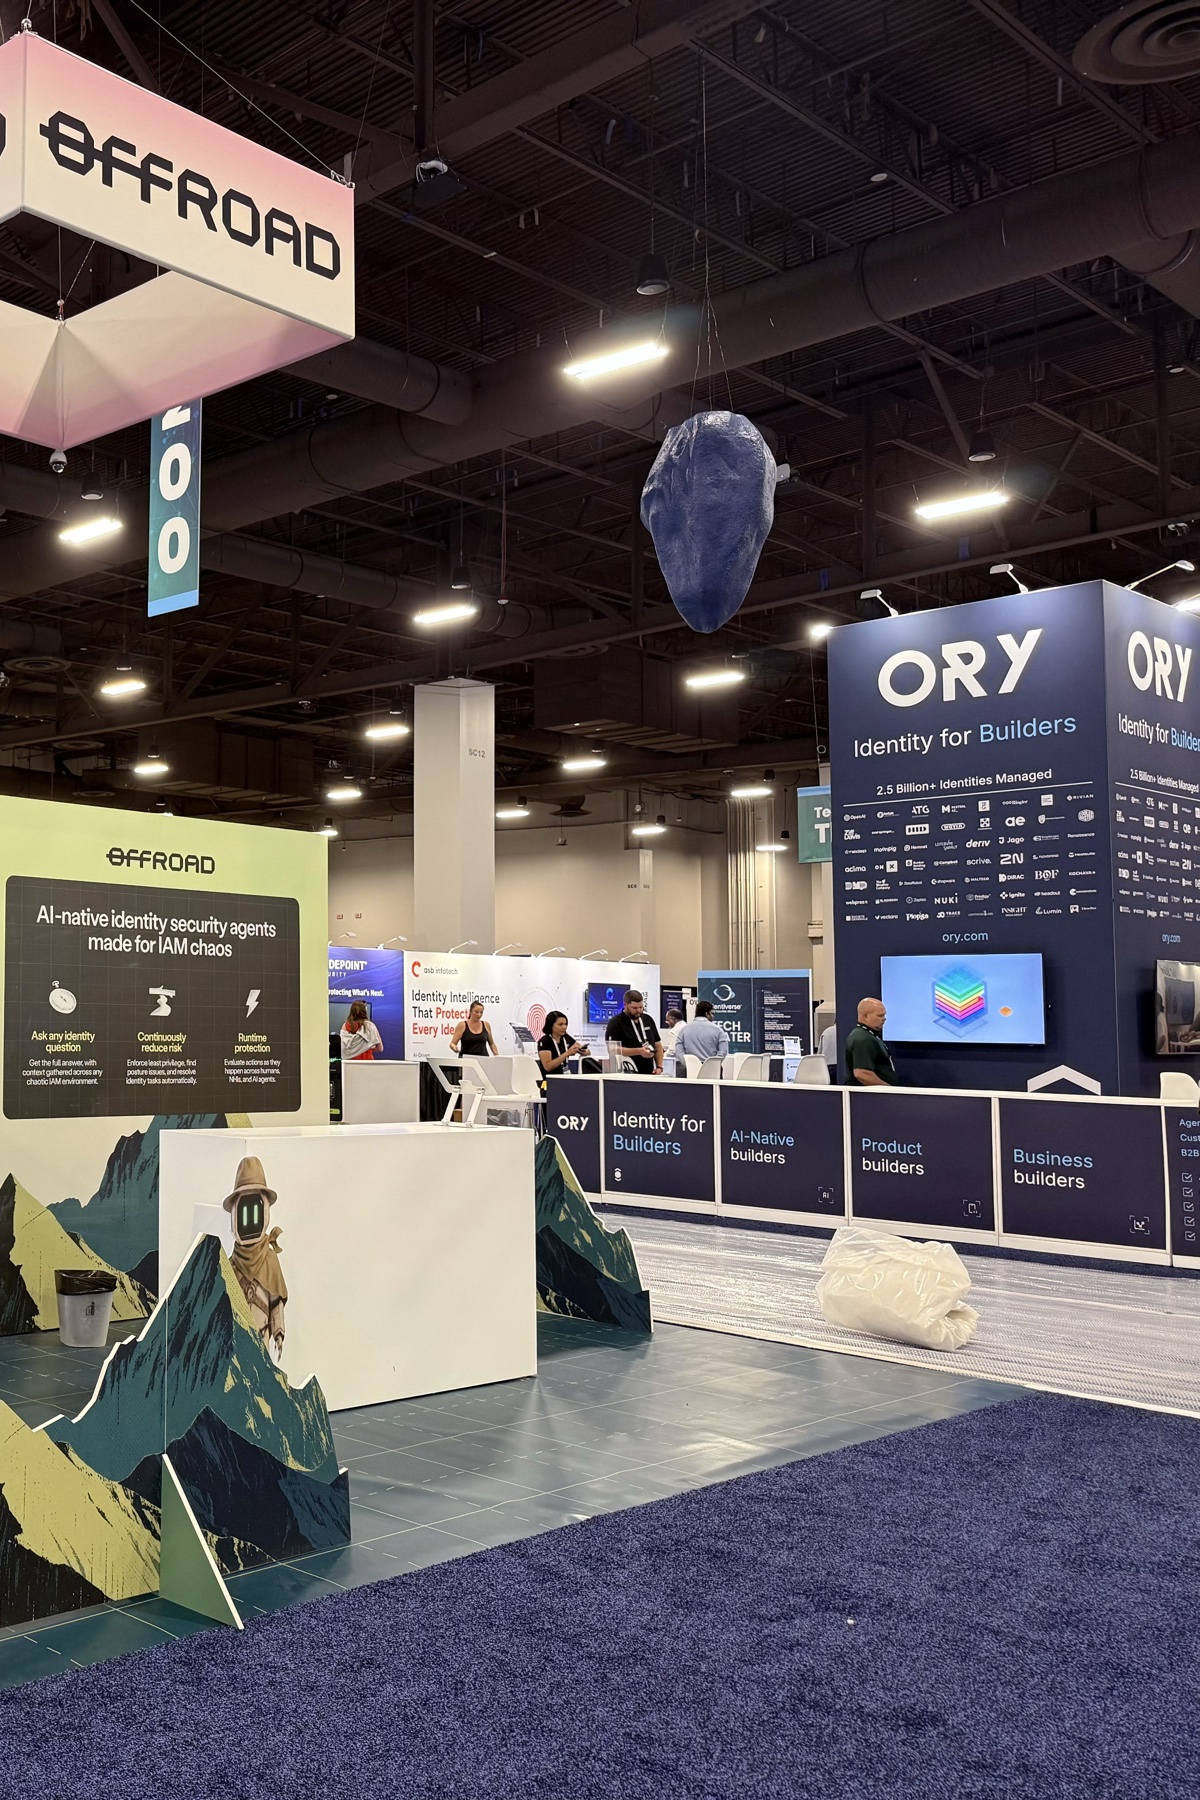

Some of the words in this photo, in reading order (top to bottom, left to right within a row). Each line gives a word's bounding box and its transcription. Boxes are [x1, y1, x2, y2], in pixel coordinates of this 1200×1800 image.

[39, 110, 341, 281] OFFROAD
[878, 628, 1043, 708] ORY
[1128, 631, 1192, 703] ORY
[1118, 713, 1154, 745] Identity
[1156, 723, 1170, 744] for
[854, 732, 933, 758] Identity
[939, 728, 972, 748] for
[979, 716, 1077, 743] Builders
[468, 748, 486, 758] SC12
[876, 785, 894, 796] 2.5
[896, 780, 937, 794] Billion+
[939, 775, 993, 790] Identities
[996, 769, 1052, 786] Managed
[1157, 775, 1178, 789] Identities
[1178, 780, 1200, 794] Managed
[911, 805, 930, 815] ATG
[965, 839, 991, 848] deriv
[106, 847, 216, 875] OFFROAD
[1000, 852, 1024, 865] 2N
[36, 905, 109, 927] AI-native
[111, 909, 169, 934] identity
[170, 916, 229, 939] security
[229, 921, 277, 940] agents
[88, 934, 133, 953] made
[134, 935, 157, 954] for
[158, 936, 189, 955] IAM
[190, 939, 233, 957] chaos
[942, 933, 989, 944] ory.com
[370, 989, 385, 997] Next.
[411, 990, 447, 1005] Identity
[450, 990, 500, 1005] Intelligence
[412, 1006, 433, 1019] That
[31, 1031, 48, 1041] Ask
[48, 1033, 64, 1043] any
[64, 1031, 96, 1043] identity
[238, 1033, 268, 1042] Runtime
[412, 1023, 438, 1038] Every
[137, 1032, 187, 1044] Continuously
[45, 1042, 82, 1054] question
[141, 1043, 169, 1052] reduce
[169, 1043, 183, 1052] risk
[234, 1043, 271, 1054] protection
[29, 1059, 41, 1067] Get
[41, 1059, 52, 1067] the
[52, 1059, 62, 1067] full
[269, 1059, 281, 1067] they
[46, 1068, 73, 1077] gathered
[92, 1069, 103, 1077] any
[127, 1069, 148, 1077] posture
[148, 1068, 167, 1076] issues,
[224, 1067, 244, 1075] happen
[260, 1067, 281, 1075] humans,
[26, 1078, 49, 1086] chaotic
[126, 1077, 147, 1086] identity
[147, 1077, 161, 1085] tasks
[161, 1077, 197, 1086] automatically.
[557, 1115, 589, 1131] ORY
[612, 1110, 676, 1134] Identity
[680, 1115, 706, 1133] for
[613, 1134, 682, 1155] Builders
[730, 1129, 795, 1146] AI-Native
[862, 1138, 922, 1156] Product
[1180, 1148, 1200, 1157] B2B
[730, 1147, 786, 1164] builders
[1013, 1149, 1093, 1169] Business
[862, 1157, 925, 1175] builders
[1013, 1169, 1086, 1189] builders
